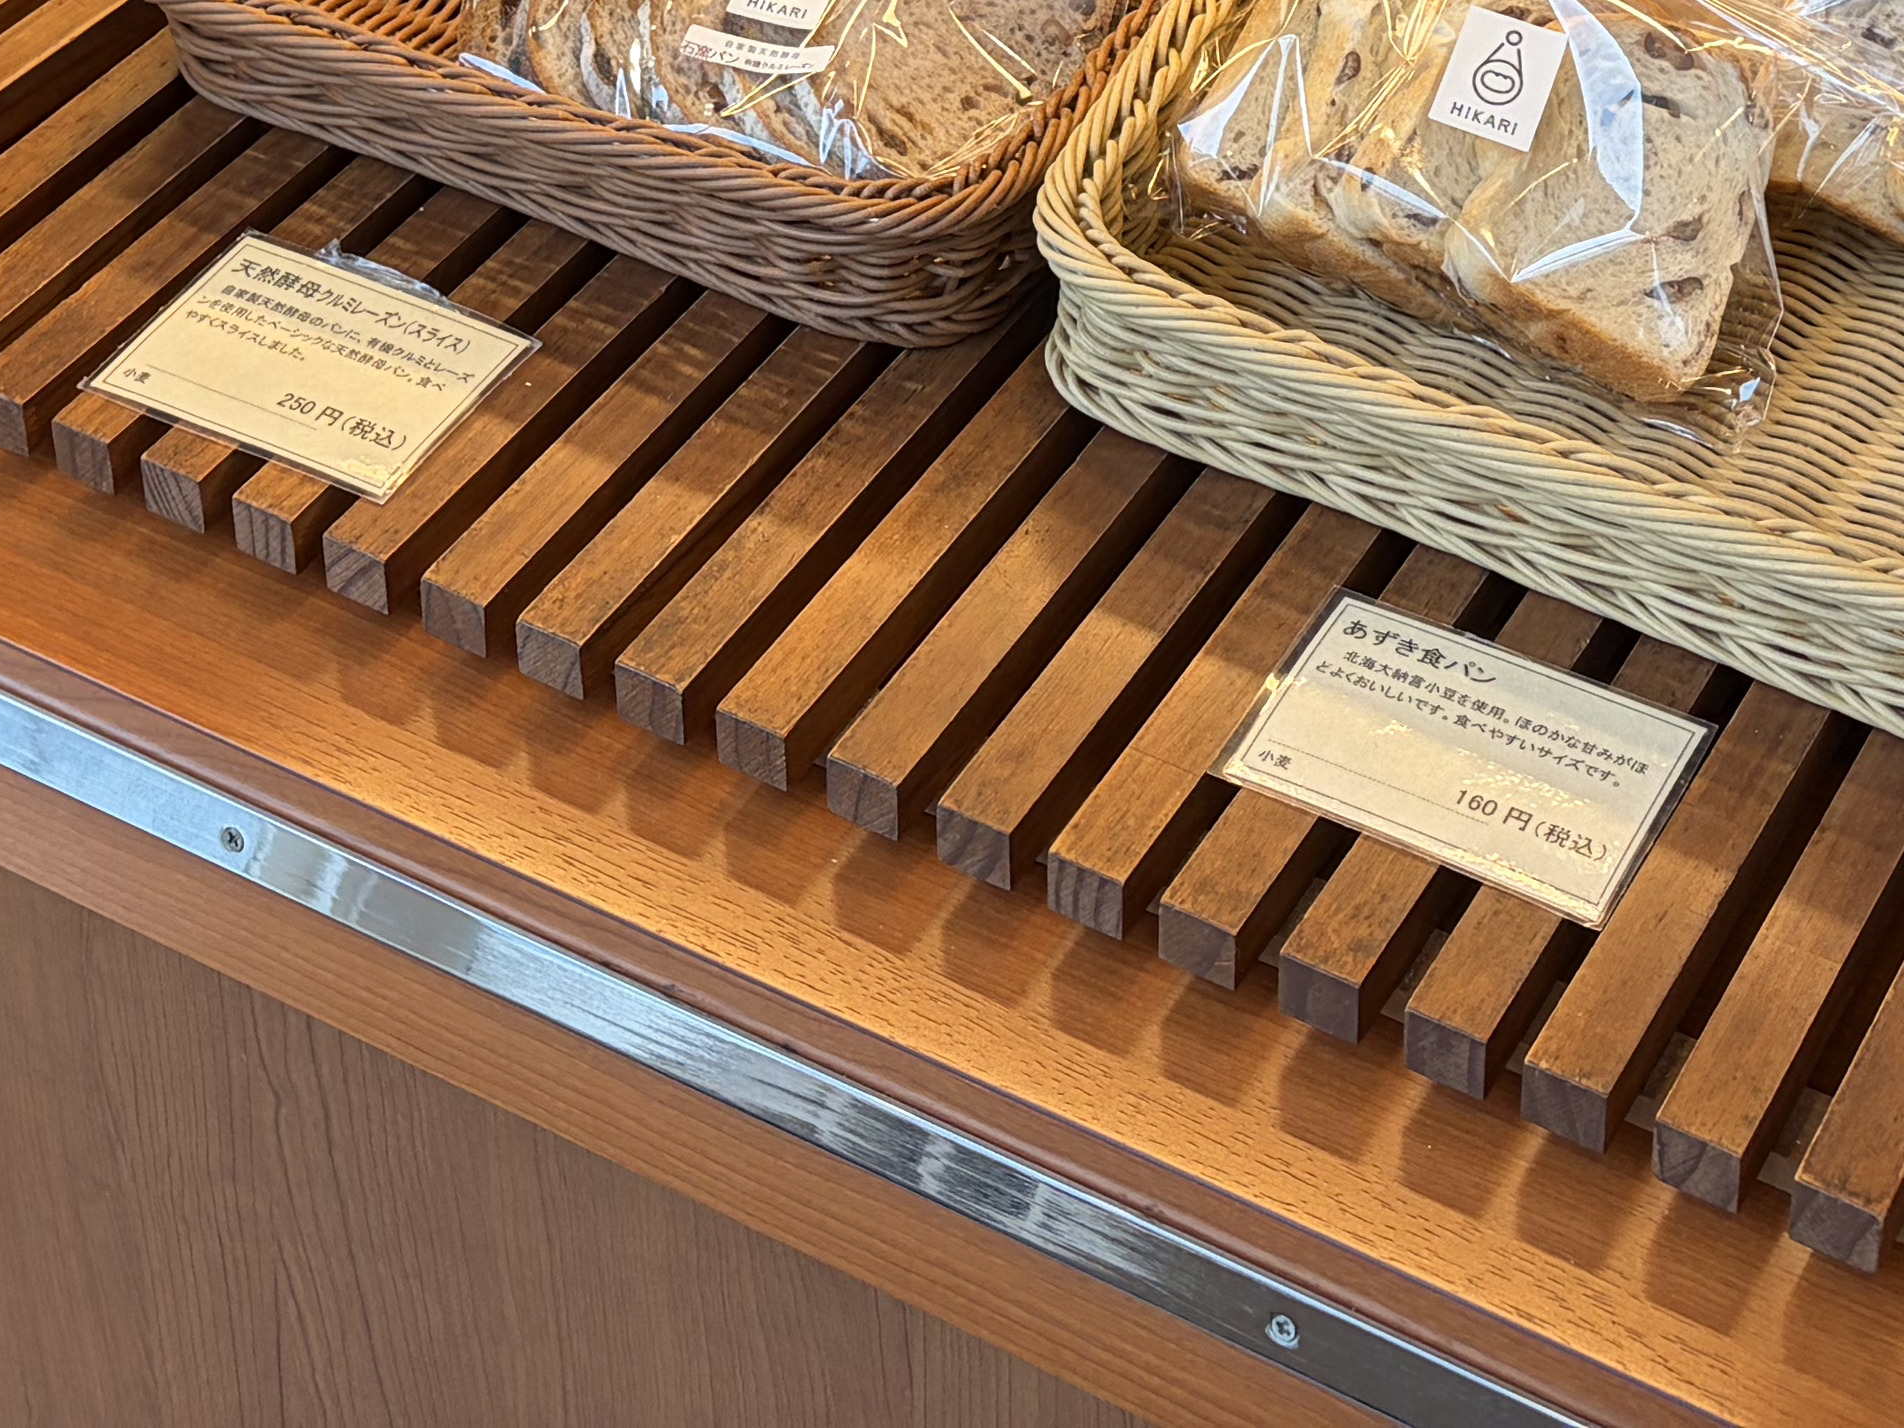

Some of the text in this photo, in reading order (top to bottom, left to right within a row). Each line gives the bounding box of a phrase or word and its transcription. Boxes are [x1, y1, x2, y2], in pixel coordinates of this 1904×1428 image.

[1450, 101, 1519, 136] HIKARI
[185, 309, 306, 362] やすくスライスしました。
[122, 366, 152, 386] 小麦
[1342, 619, 1498, 685] あずき食パン
[1315, 660, 1621, 789] どよくおいしいです。食べやすいサイズです。
[1342, 650, 1650, 775] 北海大納言小豆を使用。ほのかな甘みがほ
[1257, 748, 1293, 772] 小麦
